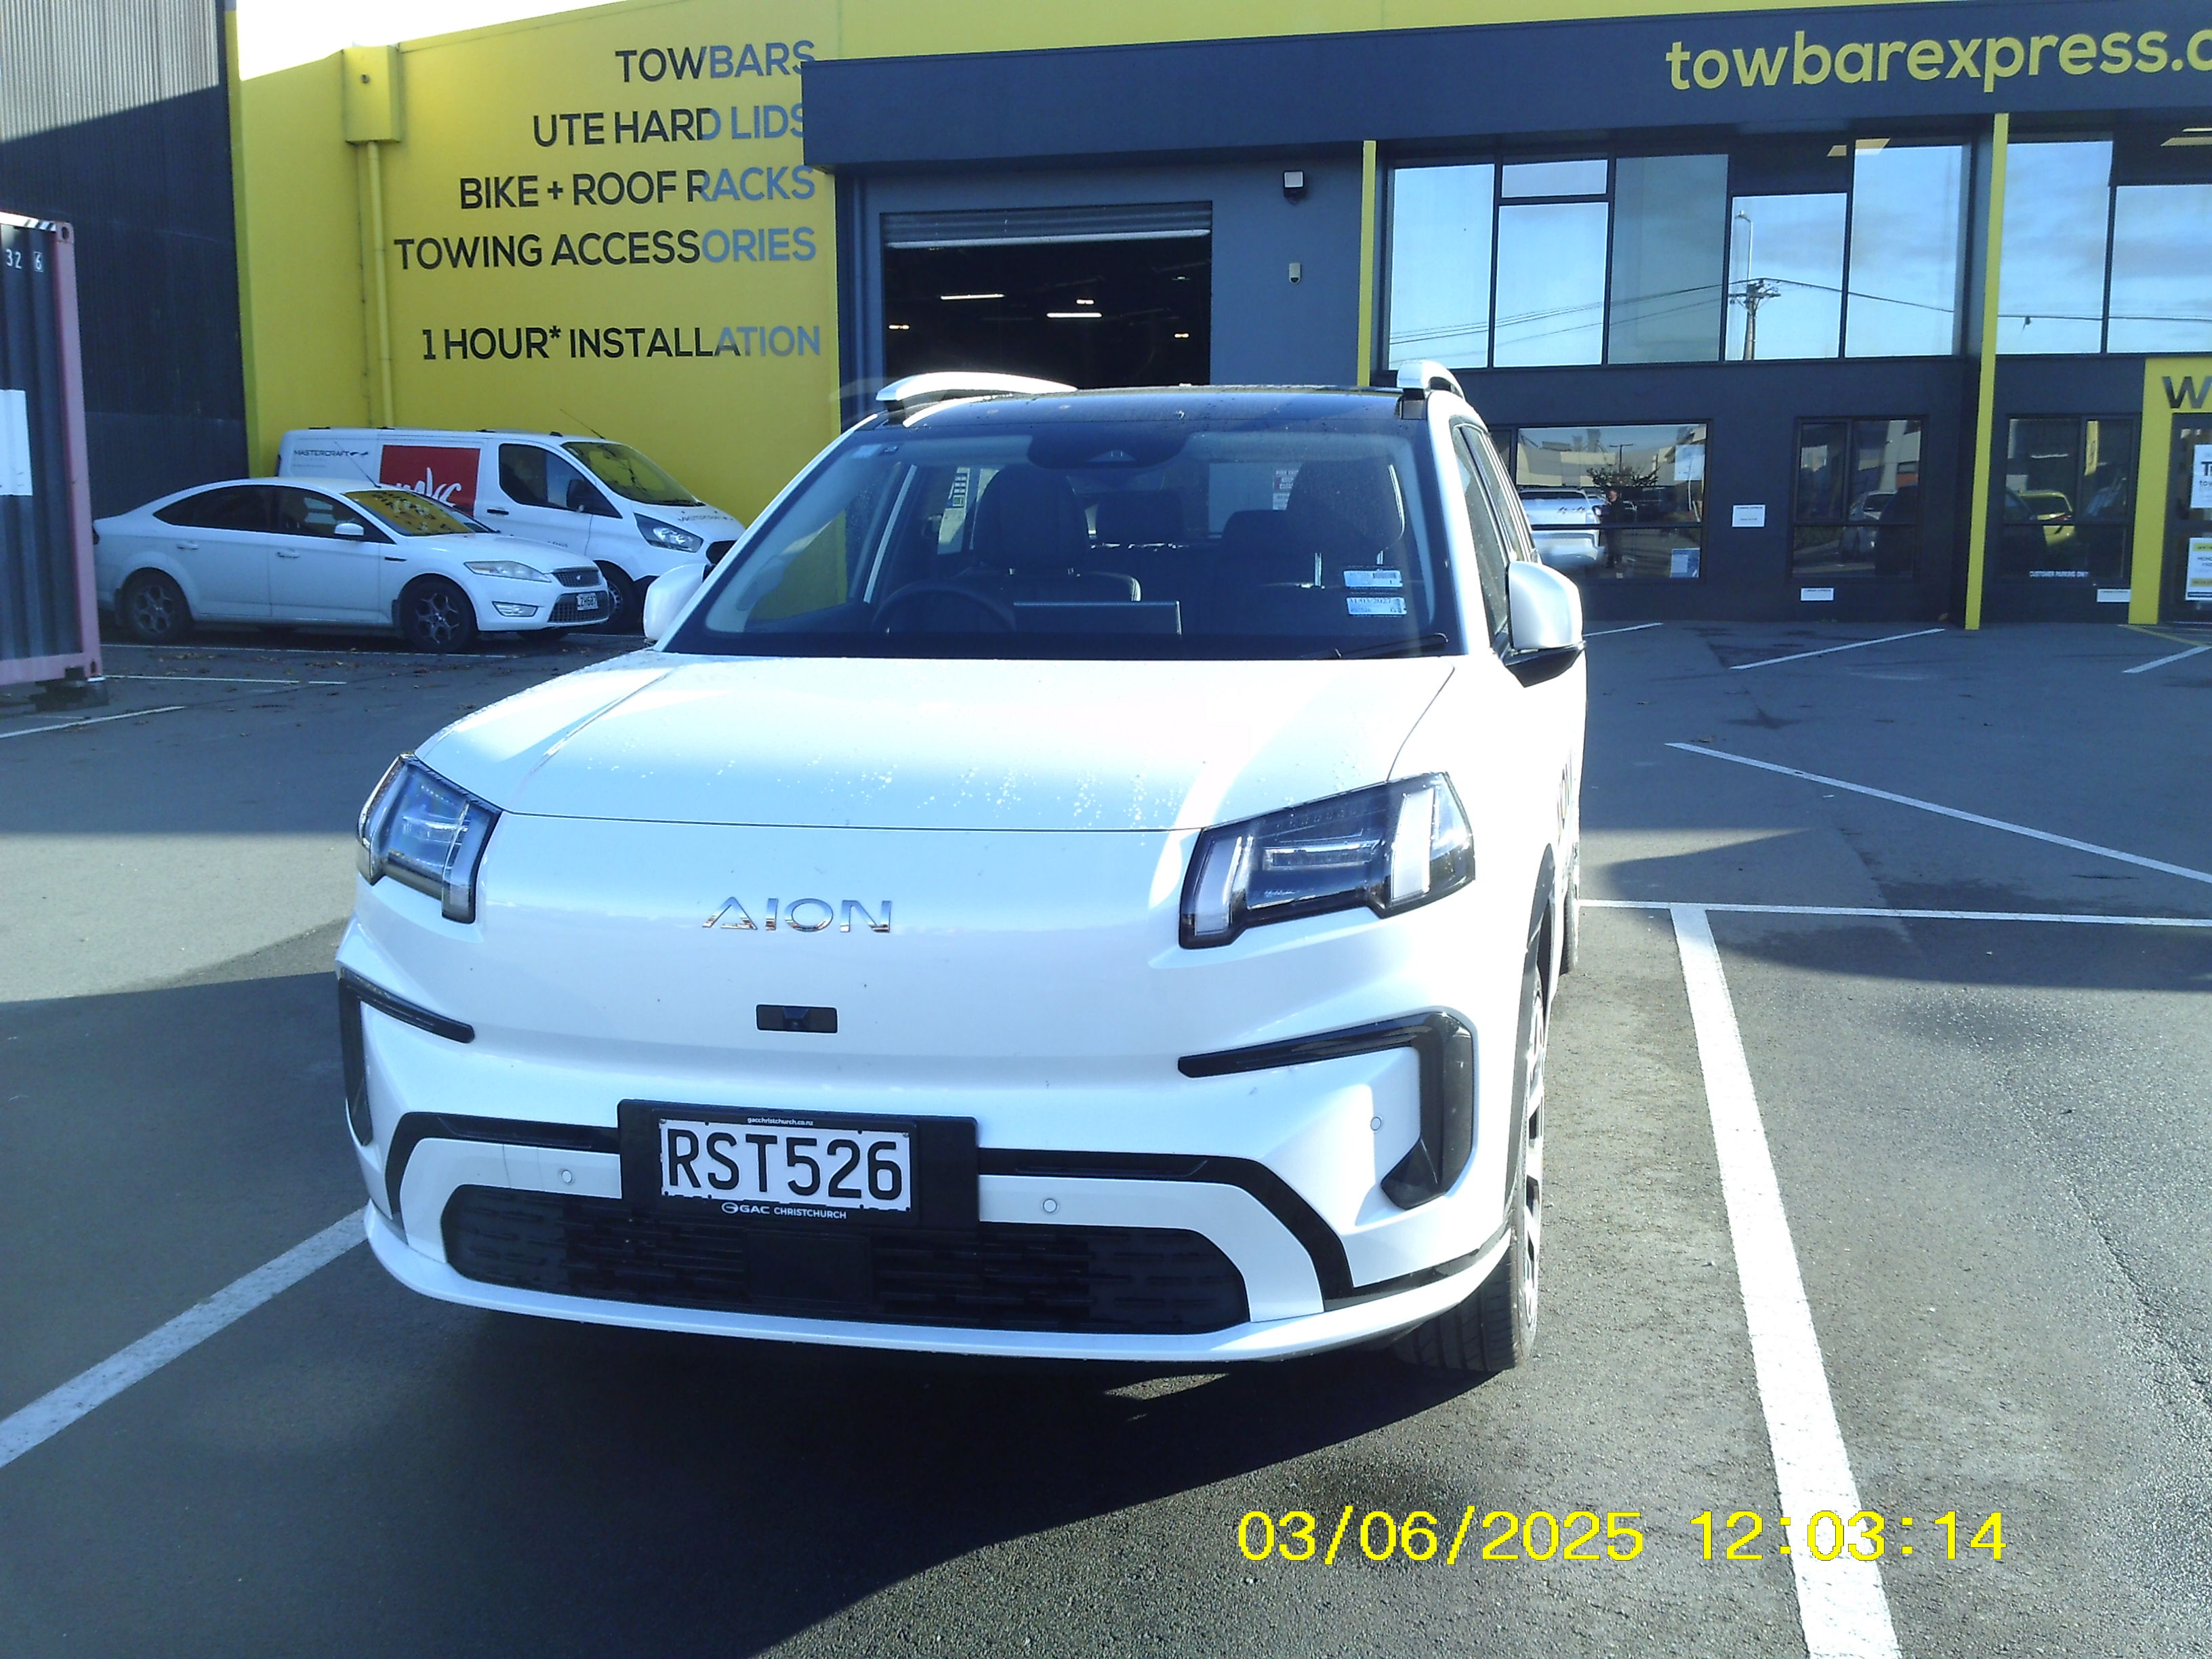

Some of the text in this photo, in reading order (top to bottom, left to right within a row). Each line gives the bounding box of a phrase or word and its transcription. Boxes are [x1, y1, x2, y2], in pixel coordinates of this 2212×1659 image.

[615, 39, 816, 83] TOWBARS
[533, 112, 605, 148] UTE
[614, 107, 721, 144] HARD
[459, 164, 816, 209] BIKE + ROOF RACKS
[394, 226, 817, 270] TOWING ACCESSORIES
[422, 328, 436, 361] 1
[570, 325, 821, 359] INSTALLATION
[701, 896, 893, 933] AION
[747, 1117, 814, 1126] gacchristchurch.co.nz
[667, 1128, 903, 1200] RST526
[739, 1204, 847, 1220] GAC CHRISTCHURCH
